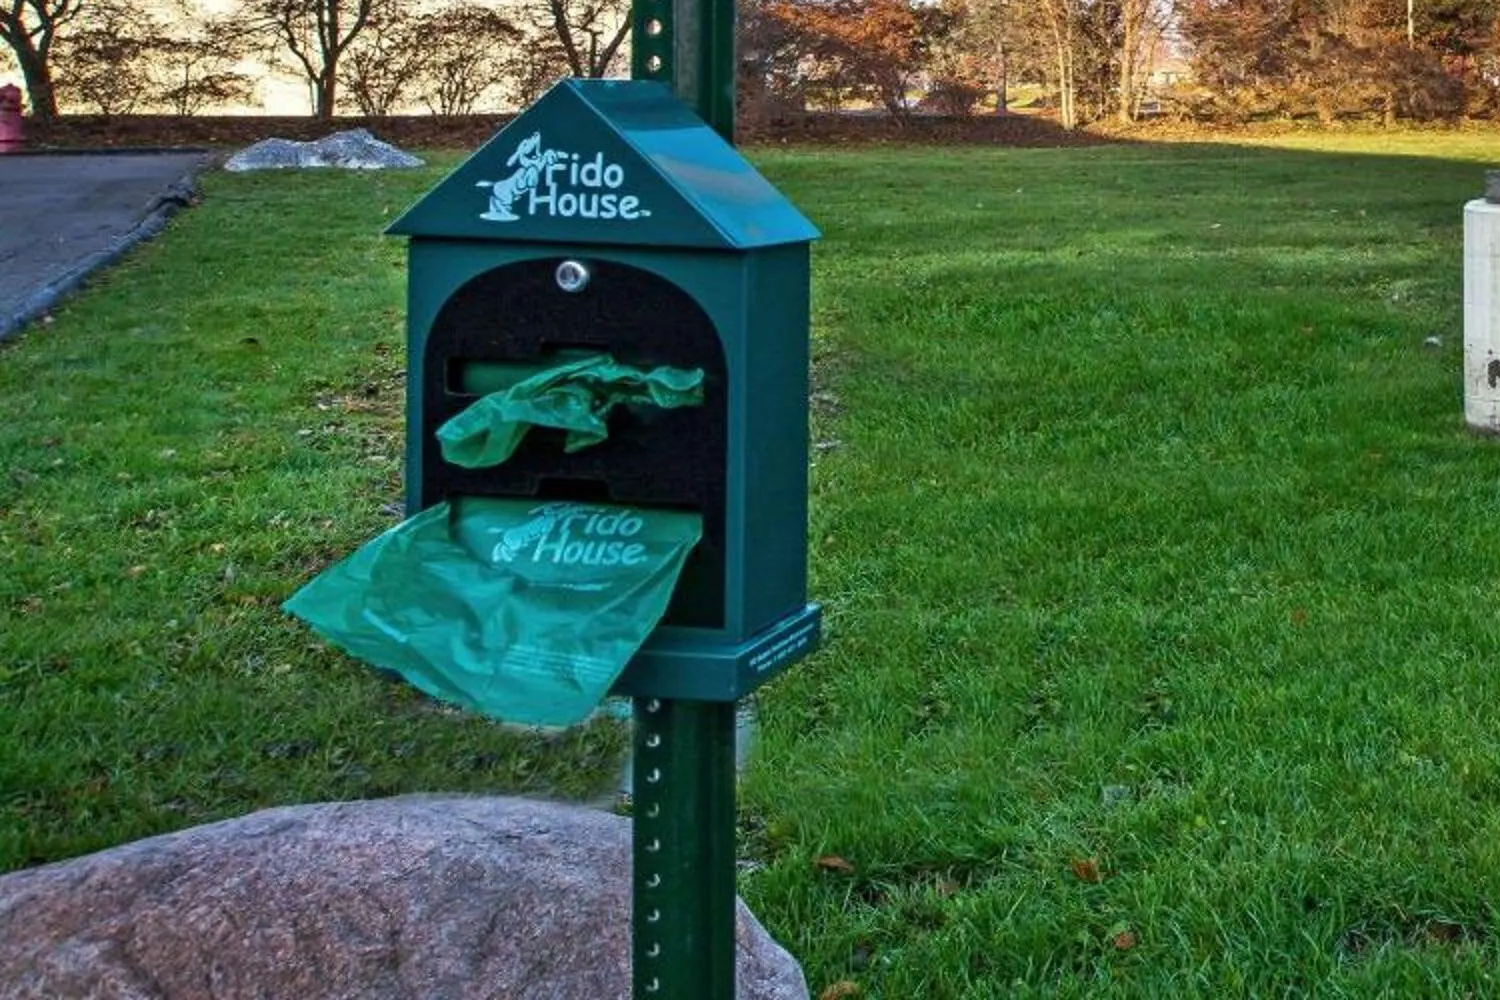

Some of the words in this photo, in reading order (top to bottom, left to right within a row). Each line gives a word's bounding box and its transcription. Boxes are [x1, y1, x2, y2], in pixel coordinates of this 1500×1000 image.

[545, 151, 625, 189] Fido
[528, 182, 641, 220] House
[532, 528, 648, 566] House
